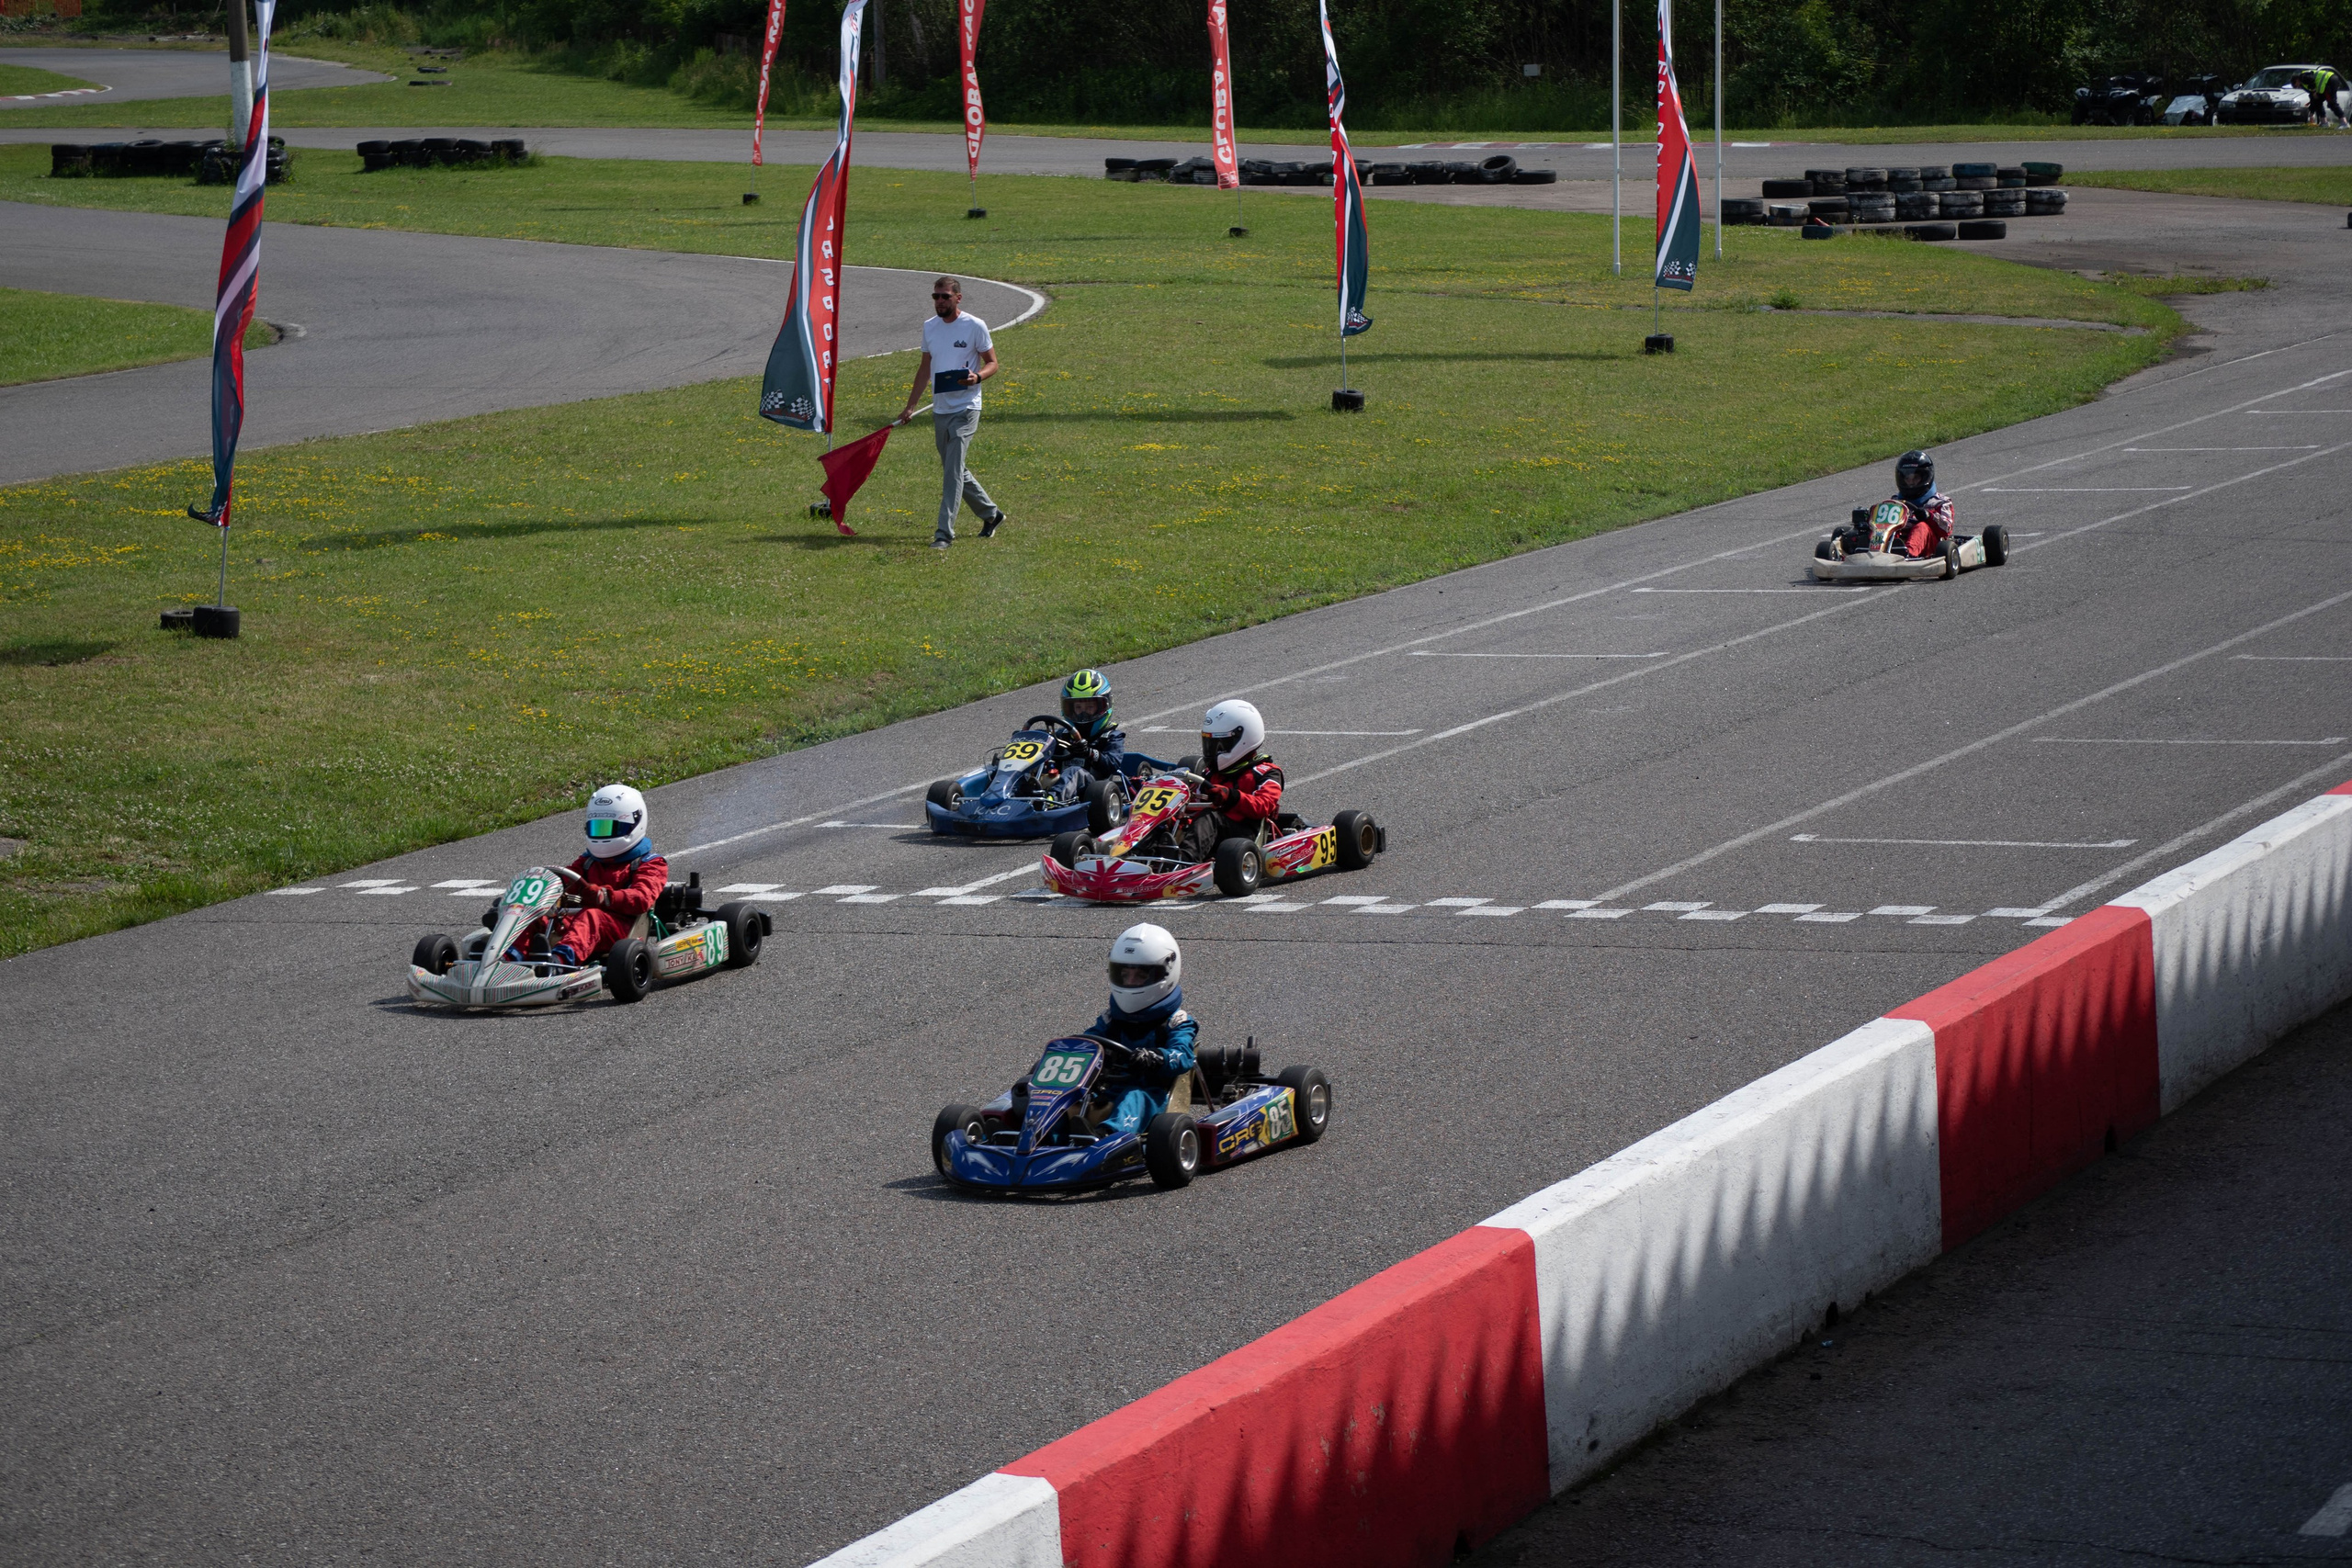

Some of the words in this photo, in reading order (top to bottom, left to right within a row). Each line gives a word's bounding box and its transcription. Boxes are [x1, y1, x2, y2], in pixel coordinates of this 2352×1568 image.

[1876, 503, 1901, 524] 96
[1001, 743, 1039, 760] 69
[1135, 789, 1174, 811] 95
[1320, 829, 1336, 864] 95
[506, 879, 544, 905] 89
[707, 927, 724, 964] 89
[1036, 1055, 1086, 1083] 85
[1269, 1099, 1292, 1139] 85
[1218, 1120, 1263, 1154] CRG
